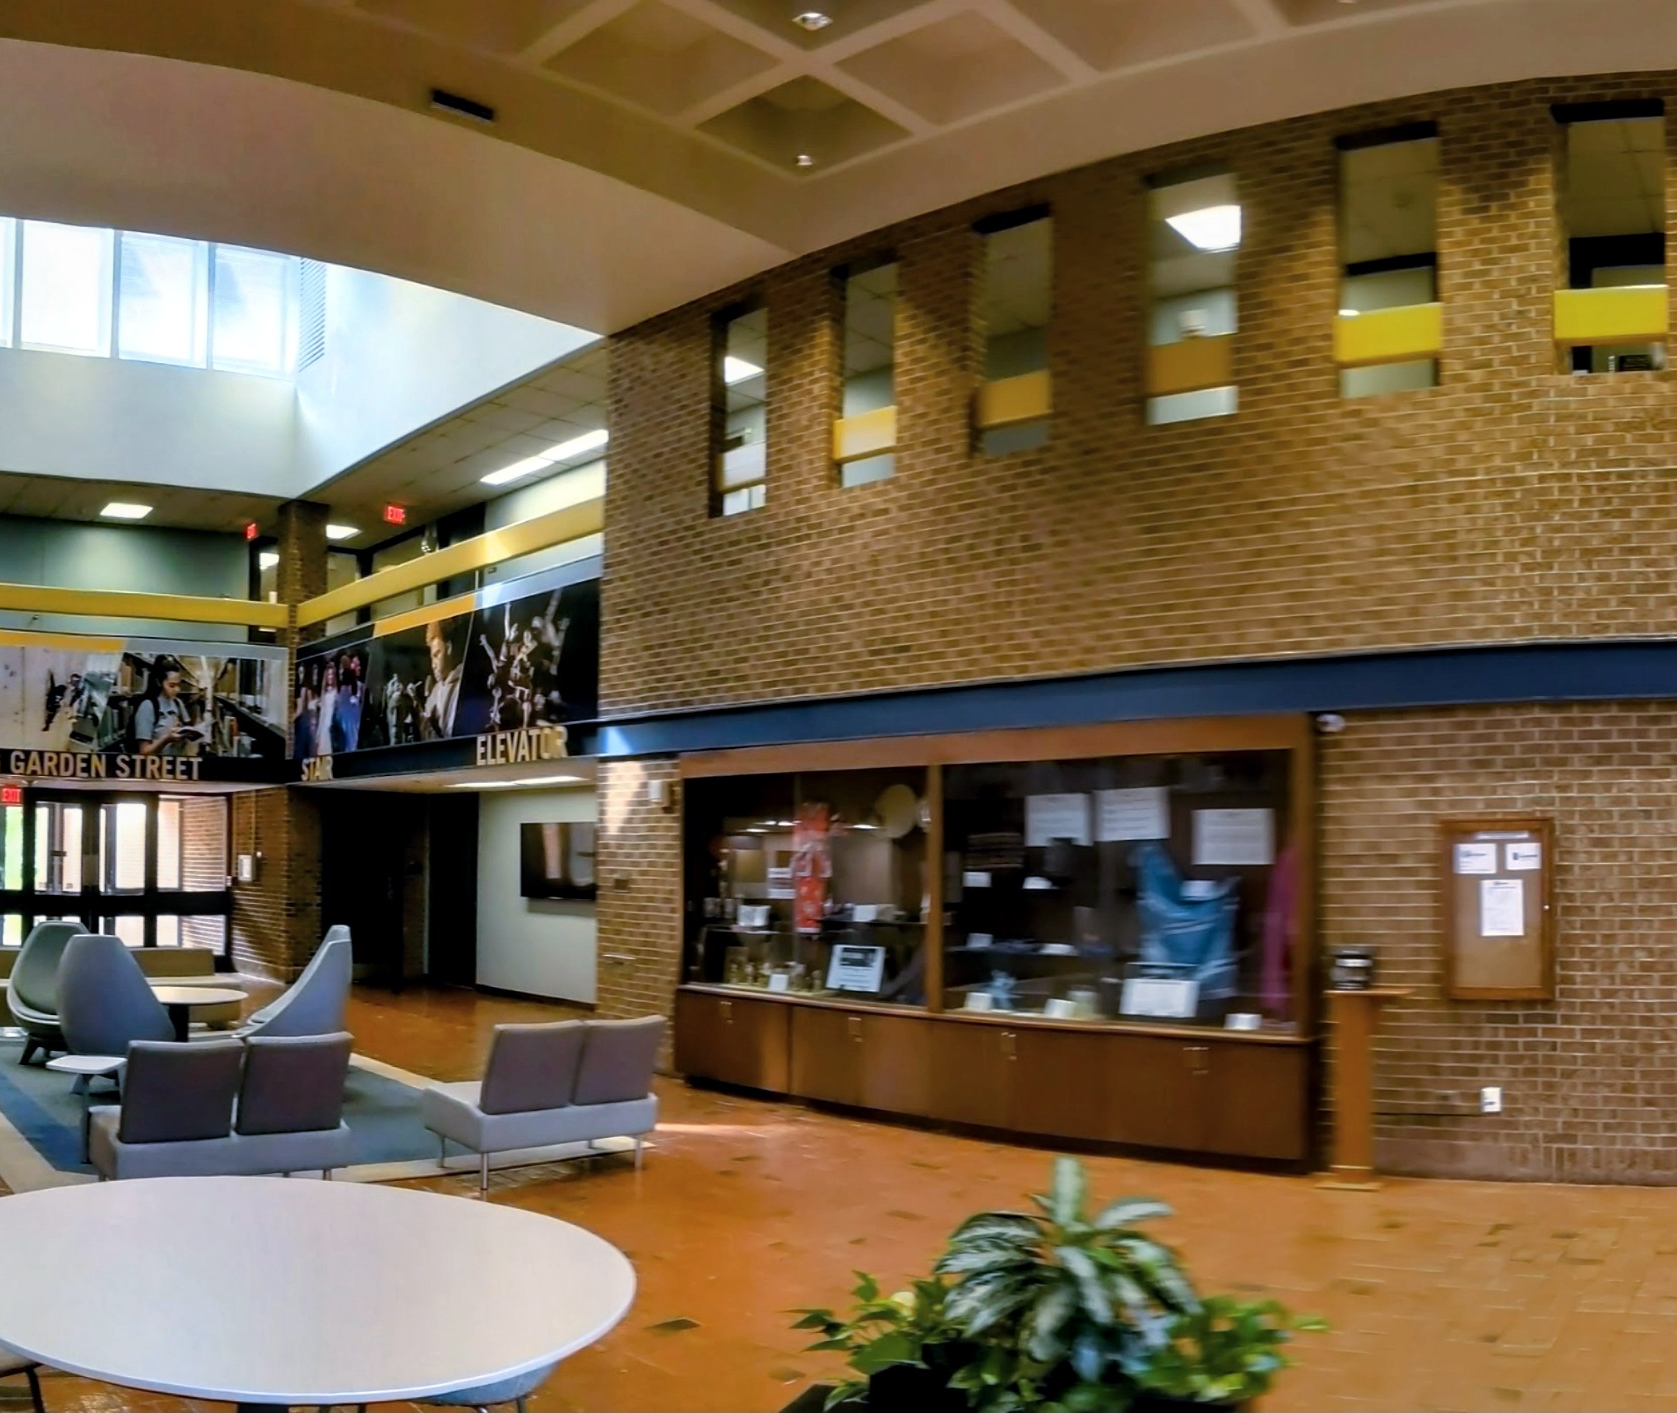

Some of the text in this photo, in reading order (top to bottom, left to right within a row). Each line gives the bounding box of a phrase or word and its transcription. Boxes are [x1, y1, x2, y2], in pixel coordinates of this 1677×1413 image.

[476, 724, 569, 766] ELEVATOR
[10, 751, 107, 778] GARDEN
[115, 754, 203, 780] STREET
[301, 755, 333, 782] STAIR
[1, 788, 22, 802] EXIT
